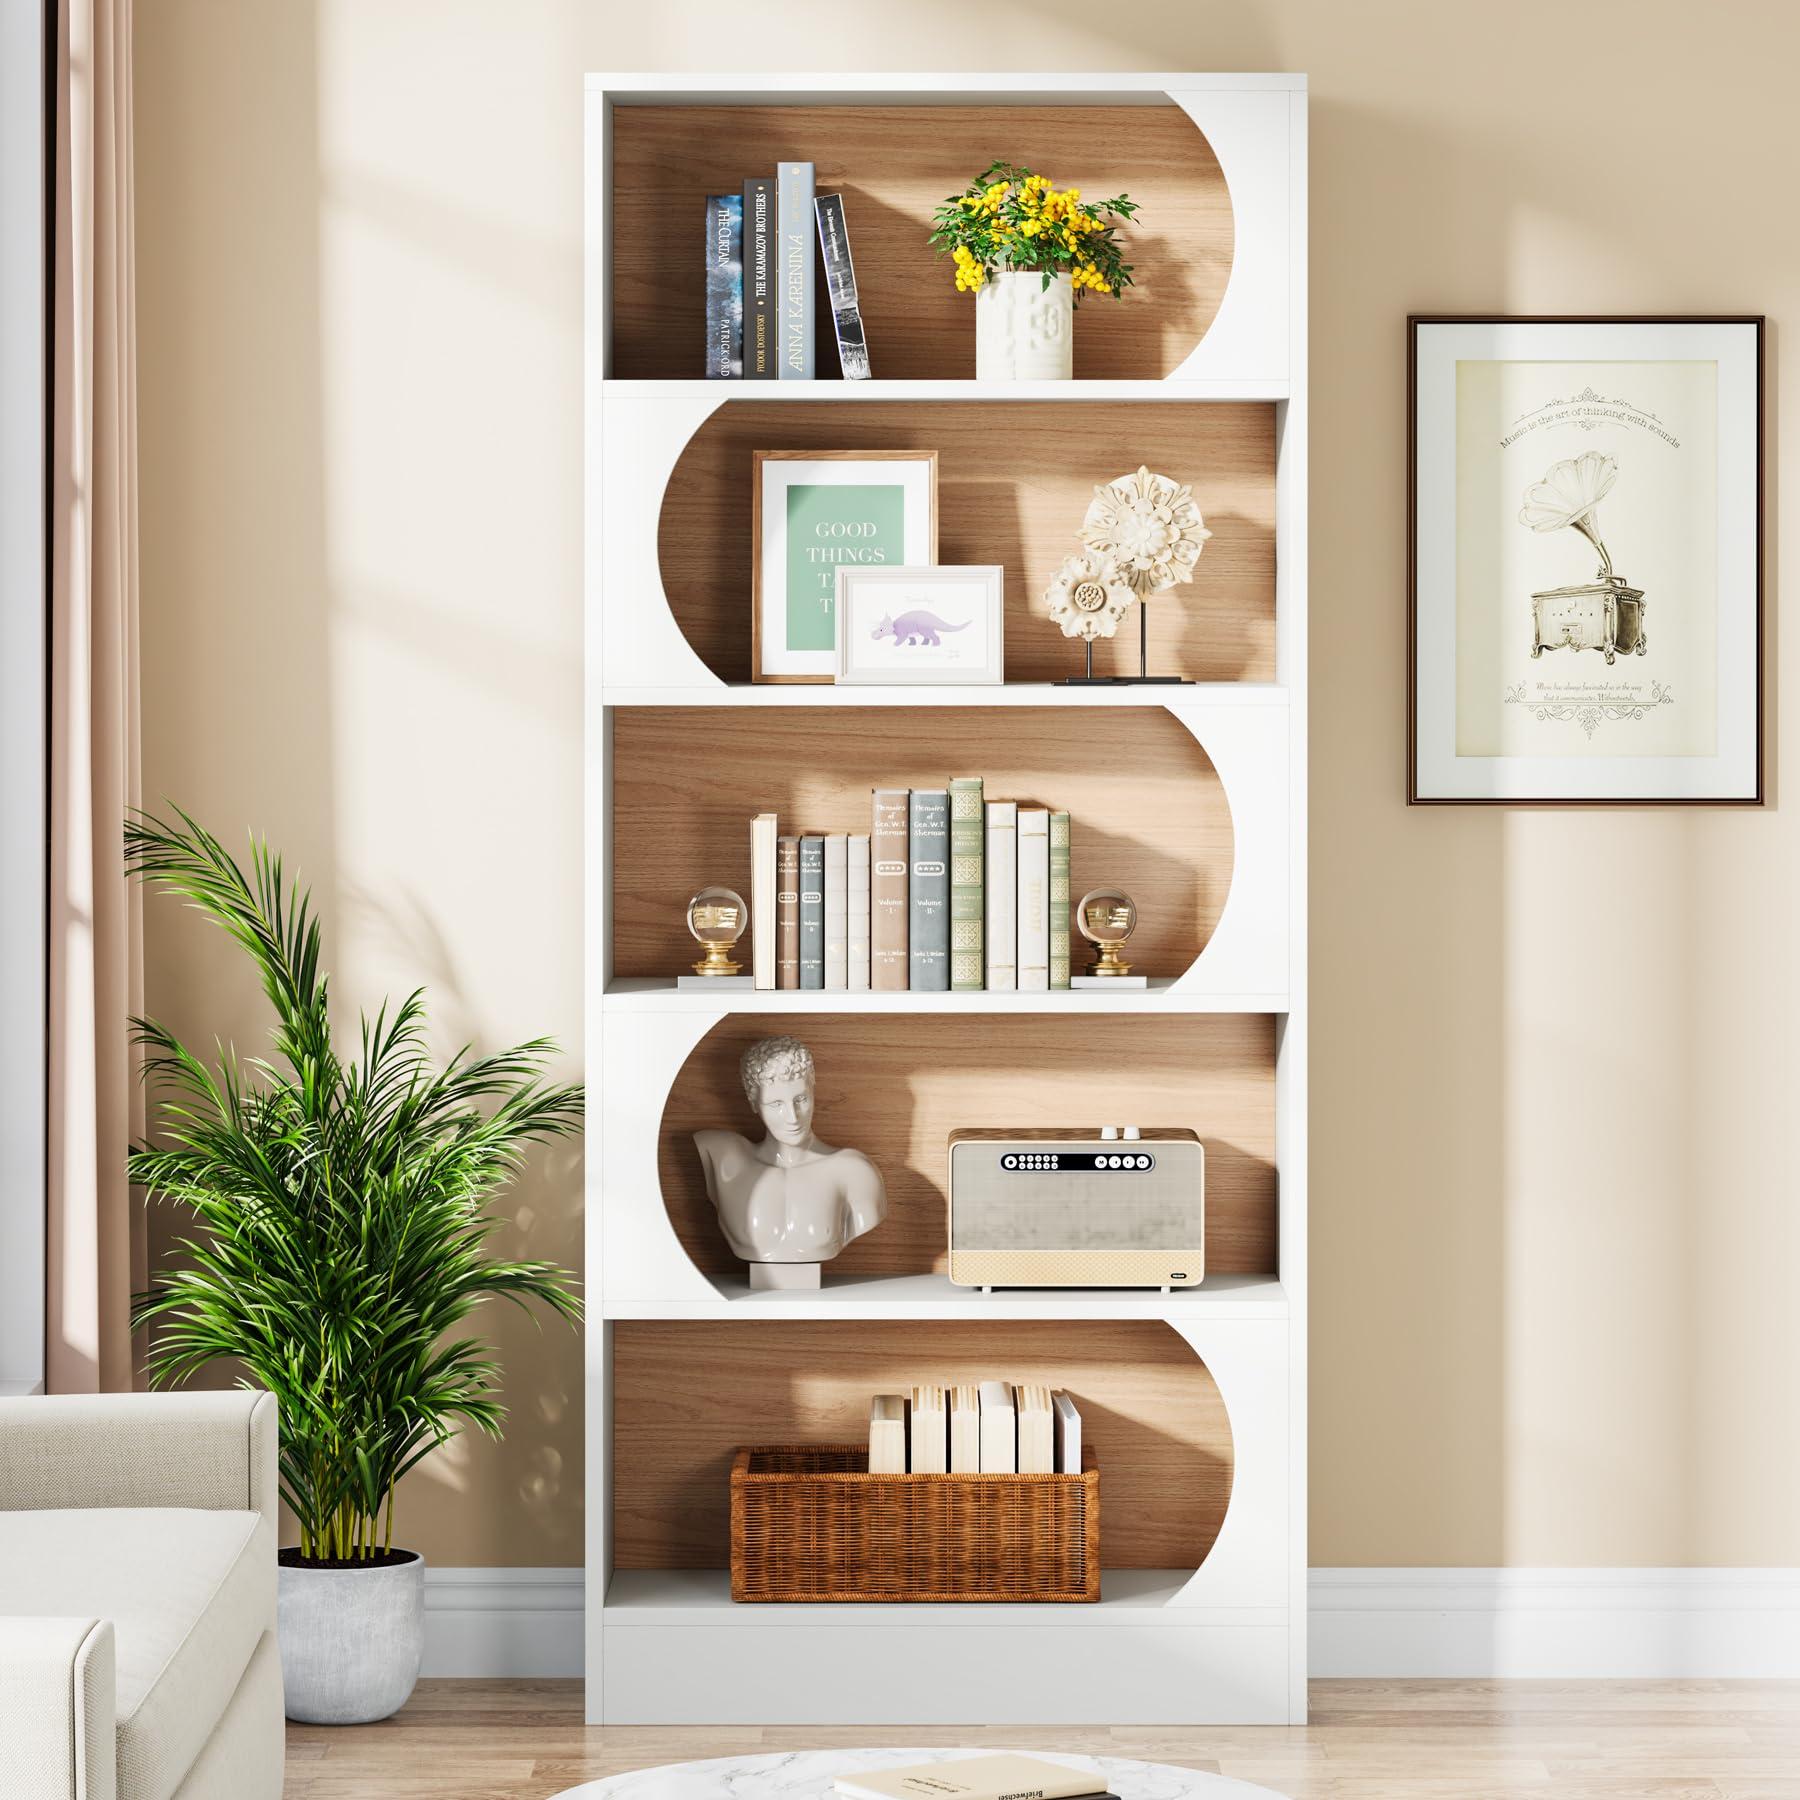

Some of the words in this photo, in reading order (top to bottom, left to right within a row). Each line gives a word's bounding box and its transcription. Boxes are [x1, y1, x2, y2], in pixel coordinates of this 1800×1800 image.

[718, 208, 730, 228] THE
[755, 193, 767, 233] BROTHERS
[717, 227, 732, 268] CURTAIN
[755, 232, 767, 281] KARAMAZOV
[755, 281, 767, 298] THE
[787, 233, 804, 319] KARENINA
[720, 319, 731, 356] PATRICK
[787, 323, 804, 374] ANNA
[720, 357, 731, 377] ORD
[756, 347, 766, 374] FYODOR
[1499, 426, 1528, 450] Music
[1528, 421, 1538, 431] is
[1537, 415, 1555, 426] the
[1555, 409, 1570, 420] art
[1571, 407, 1583, 416] of
[1583, 406, 1626, 421] thinking
[1626, 413, 1648, 428] with
[1647, 422, 1682, 450] sounds
[815, 521, 877, 538] GOOD
[805, 547, 886, 563] THINGS
[917, 898, 943, 907] Volume
